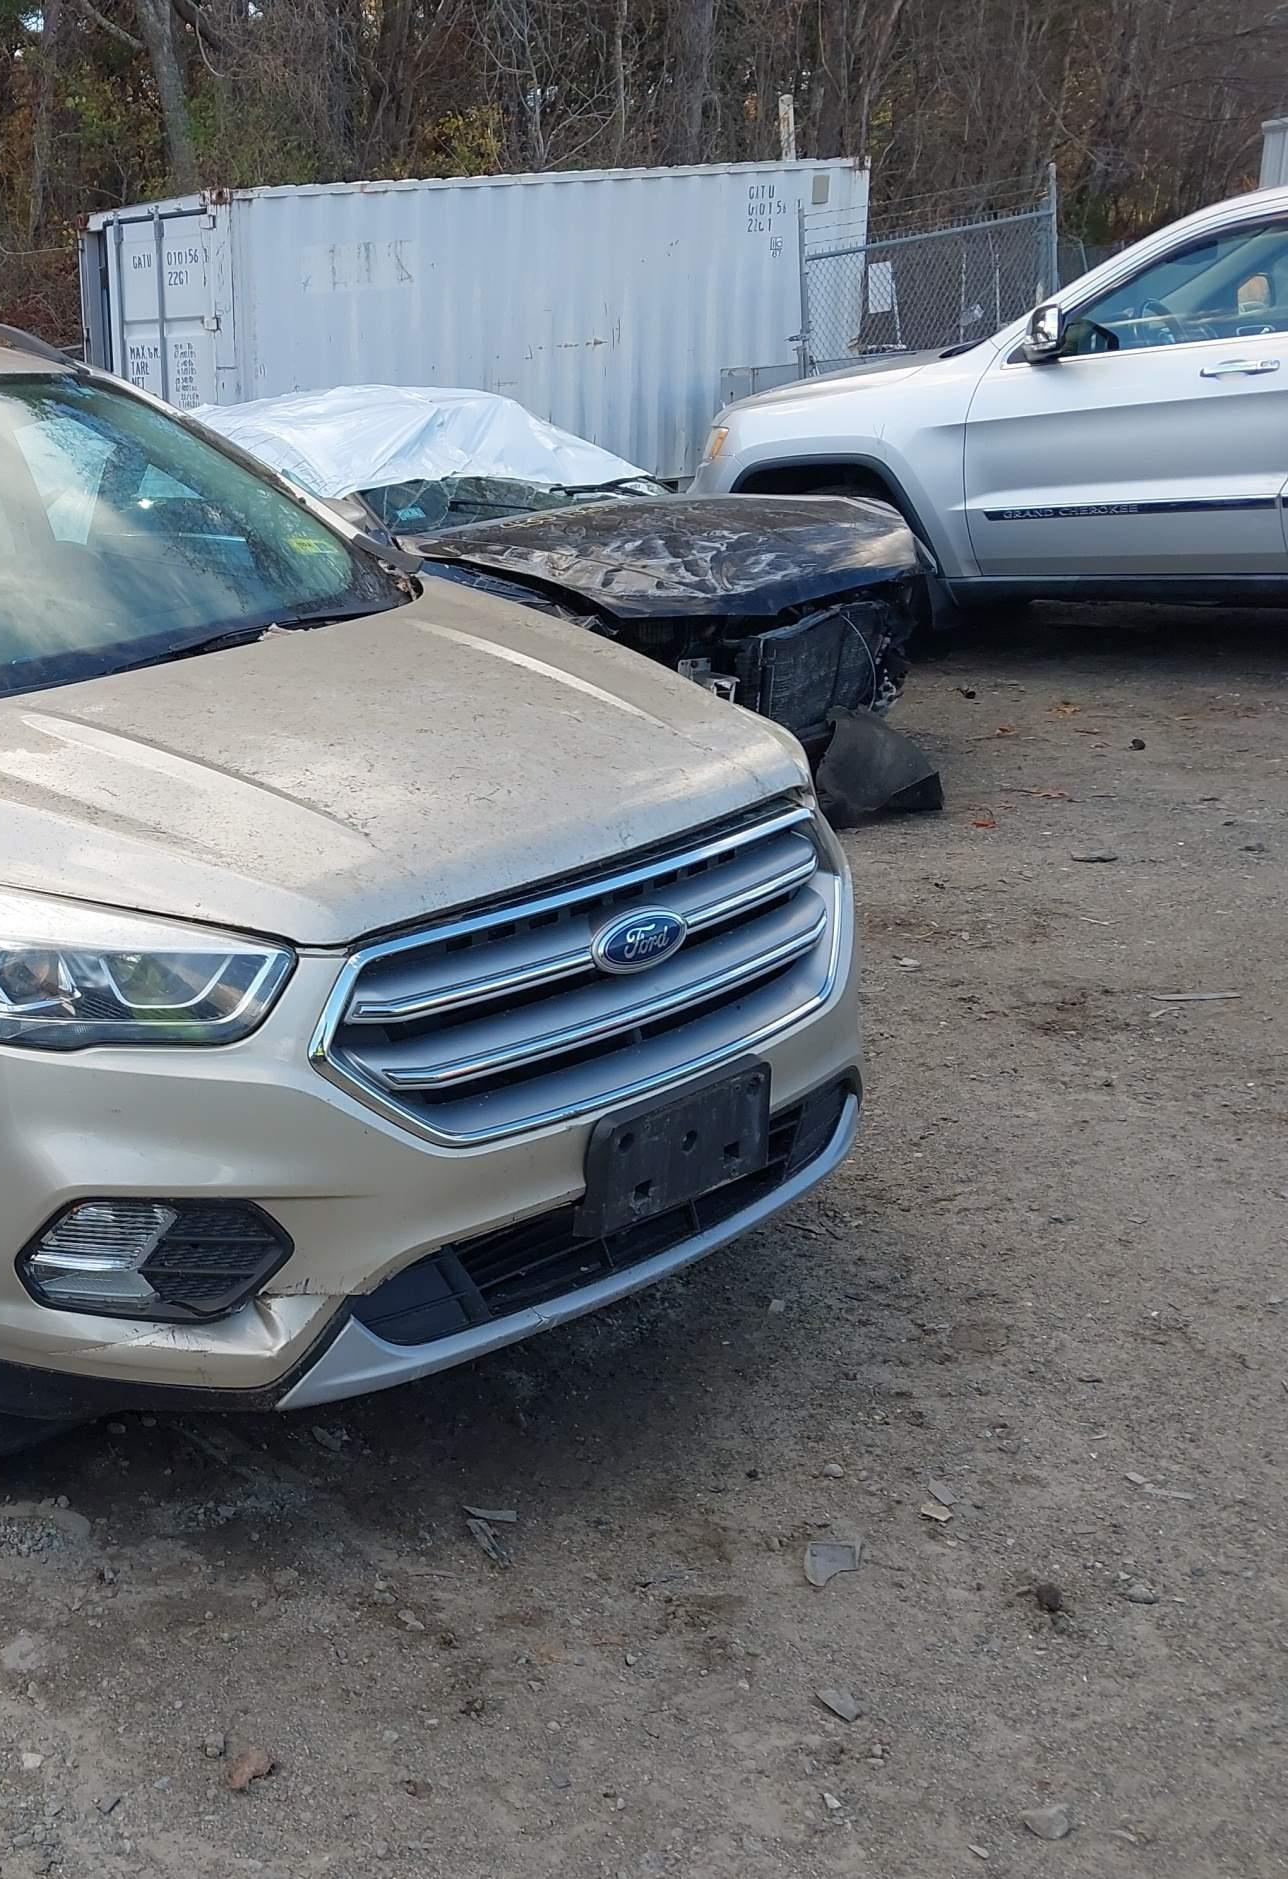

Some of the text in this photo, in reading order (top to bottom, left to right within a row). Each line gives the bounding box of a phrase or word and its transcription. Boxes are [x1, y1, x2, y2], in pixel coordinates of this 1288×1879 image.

[132, 248, 199, 269] GATU 010156
[167, 270, 189, 286] 22G1
[1002, 504, 1139, 519] GRAND CHEROKEE
[623, 922, 670, 959] Ford
